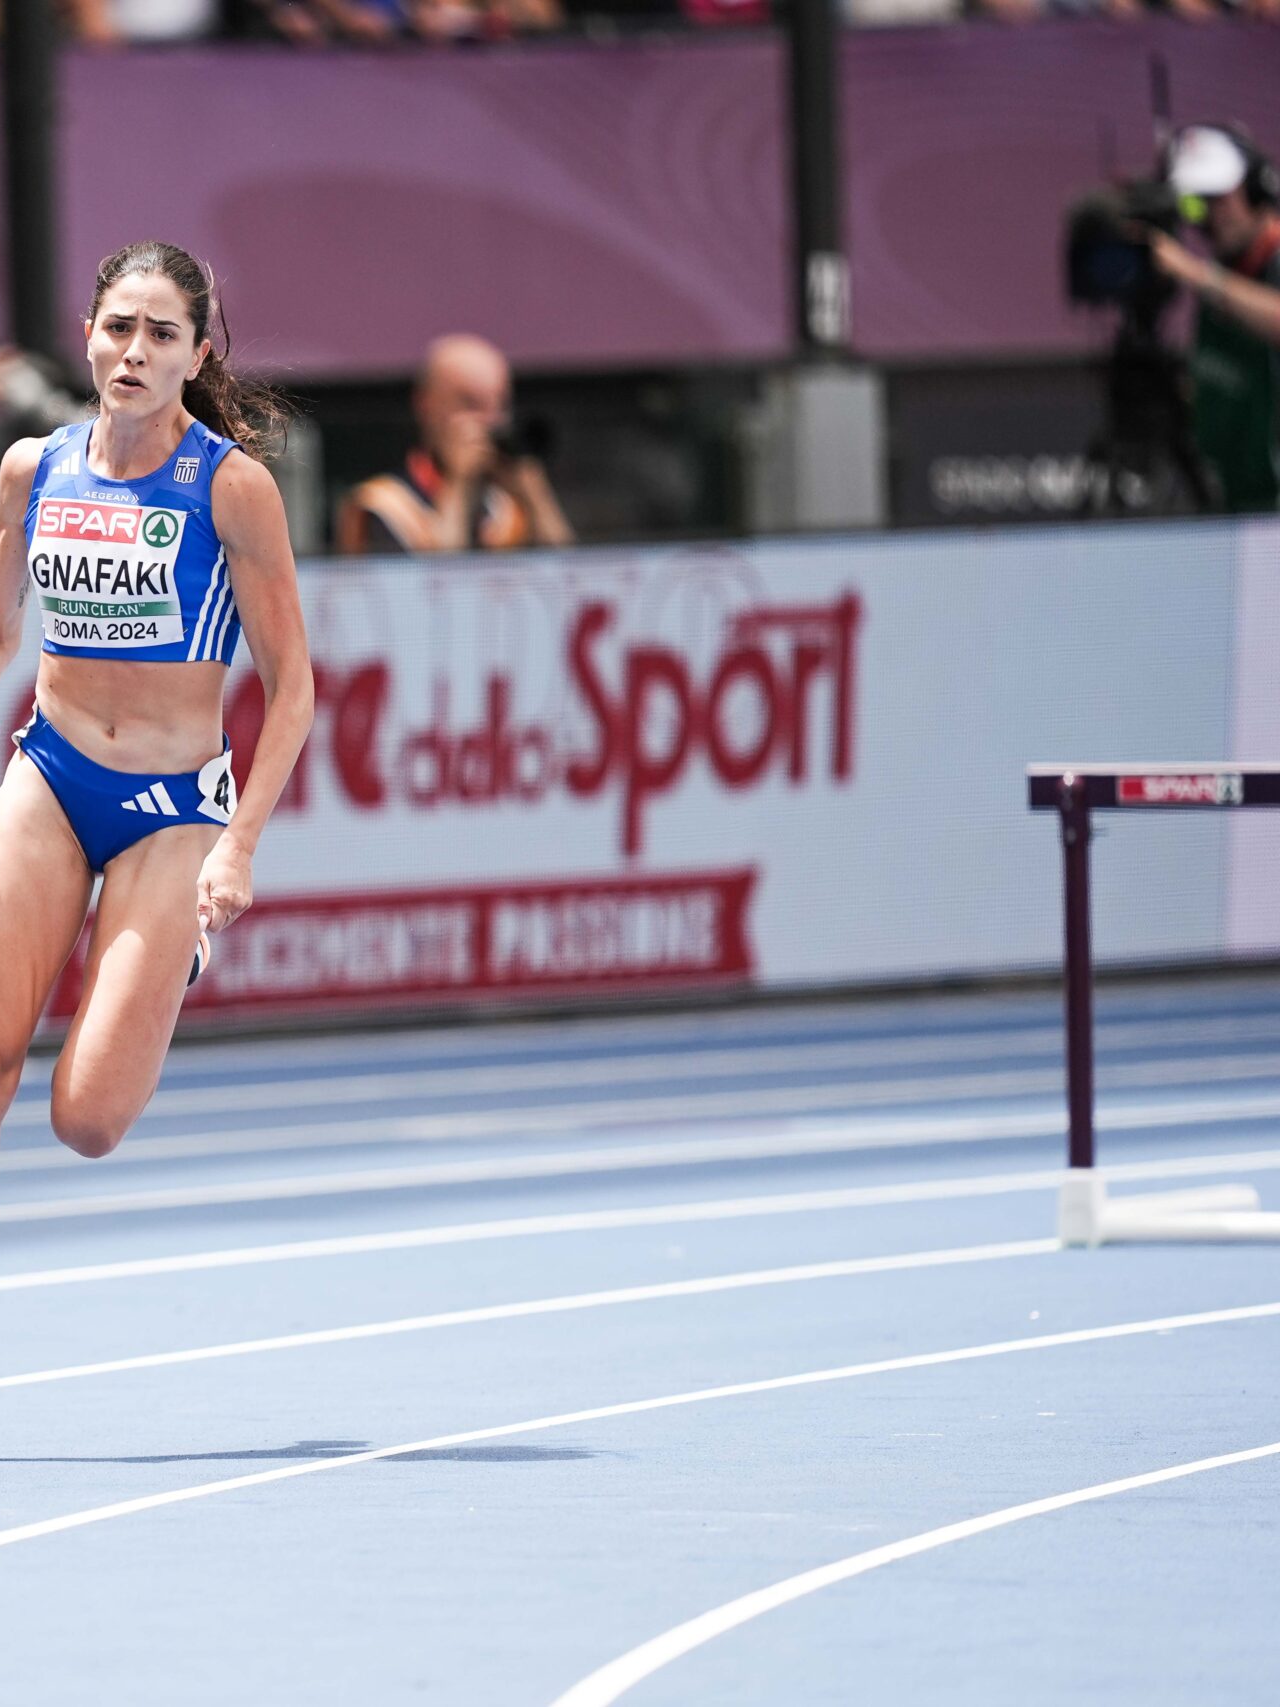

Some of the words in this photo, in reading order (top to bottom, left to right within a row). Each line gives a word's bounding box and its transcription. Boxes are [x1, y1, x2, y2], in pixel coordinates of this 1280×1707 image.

[83, 490, 130, 502] AEGEAN
[40, 505, 139, 539] SPAR
[32, 552, 169, 596] GNAFAKI
[54, 618, 102, 640] ROMA
[107, 622, 159, 640] 2024
[213, 768, 230, 815] 4
